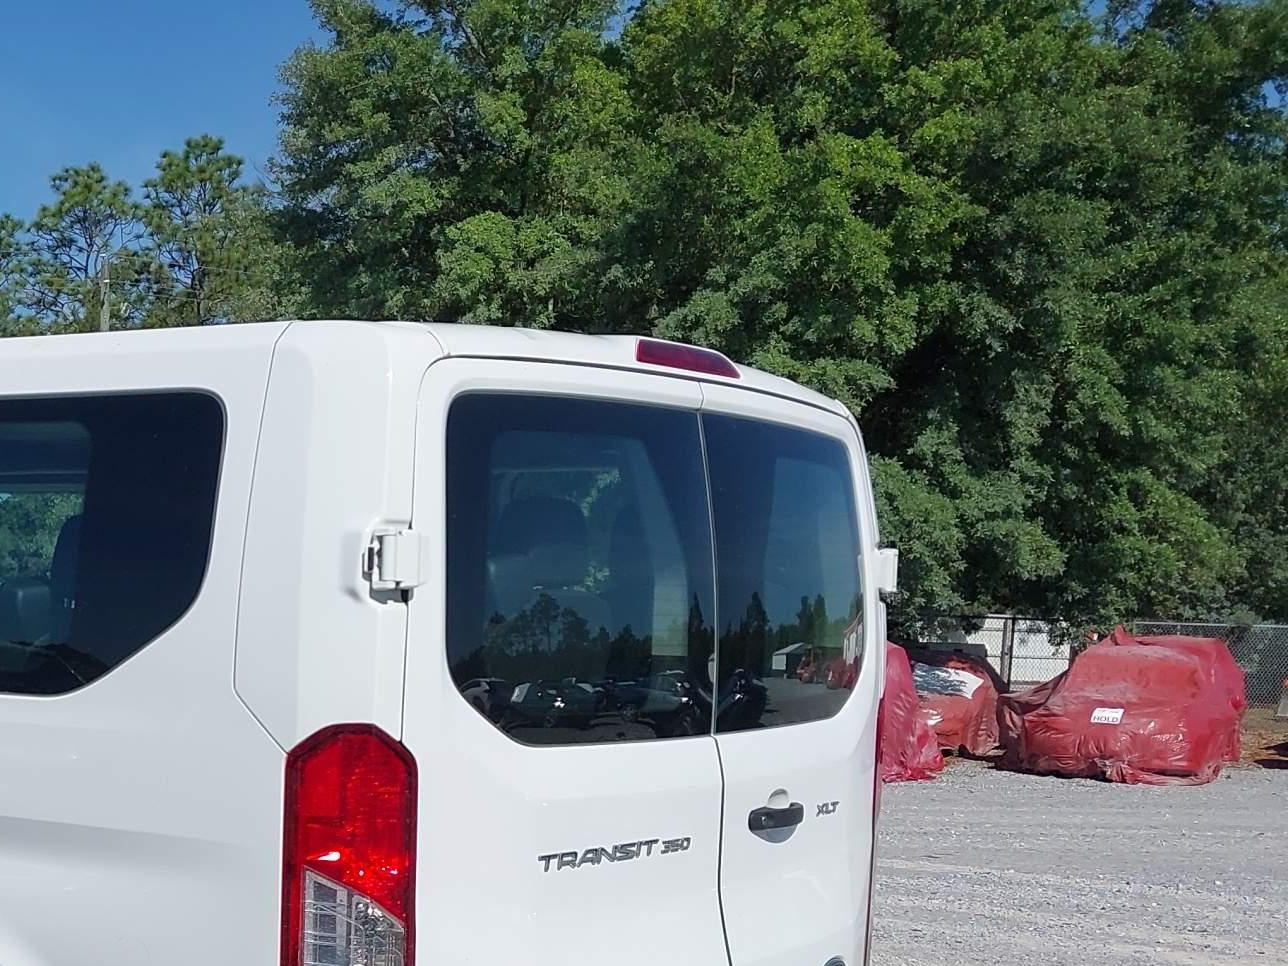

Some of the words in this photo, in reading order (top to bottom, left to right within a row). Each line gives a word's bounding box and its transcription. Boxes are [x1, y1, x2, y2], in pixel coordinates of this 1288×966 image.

[815, 801, 840, 817] XLT
[538, 839, 659, 873] TRANSIT
[661, 837, 691, 855] 350
